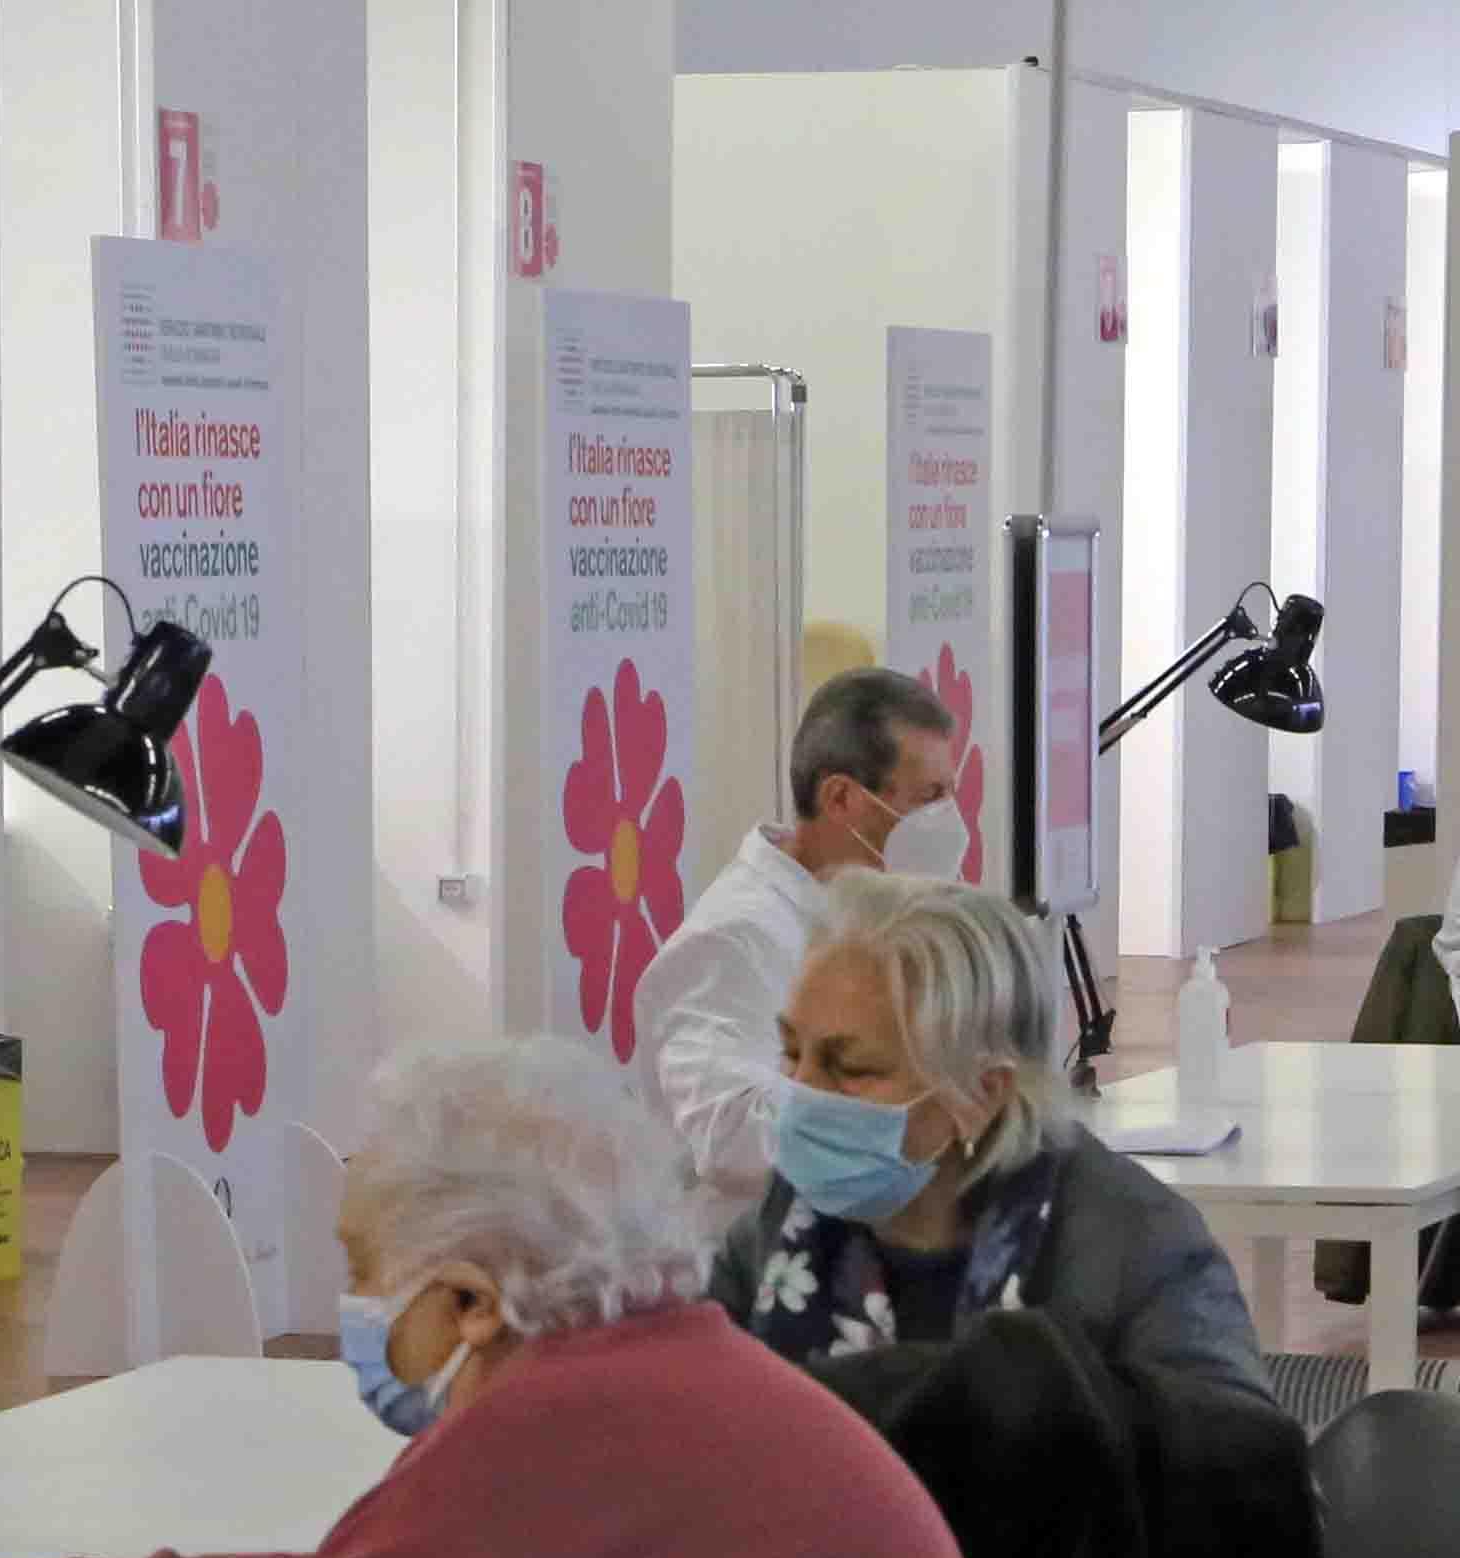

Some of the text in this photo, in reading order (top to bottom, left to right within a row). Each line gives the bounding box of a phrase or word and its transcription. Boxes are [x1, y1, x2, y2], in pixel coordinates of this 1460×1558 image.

[169, 136, 188, 225] 7
[194, 411, 262, 460] rinasce
[617, 435, 671, 479] rinasce
[138, 469, 244, 519] con un fiore
[571, 487, 656, 528] con un fiore
[140, 528, 260, 578] vaccinazione
[570, 536, 668, 577] vaccinazione
[240, 592, 261, 640] 19
